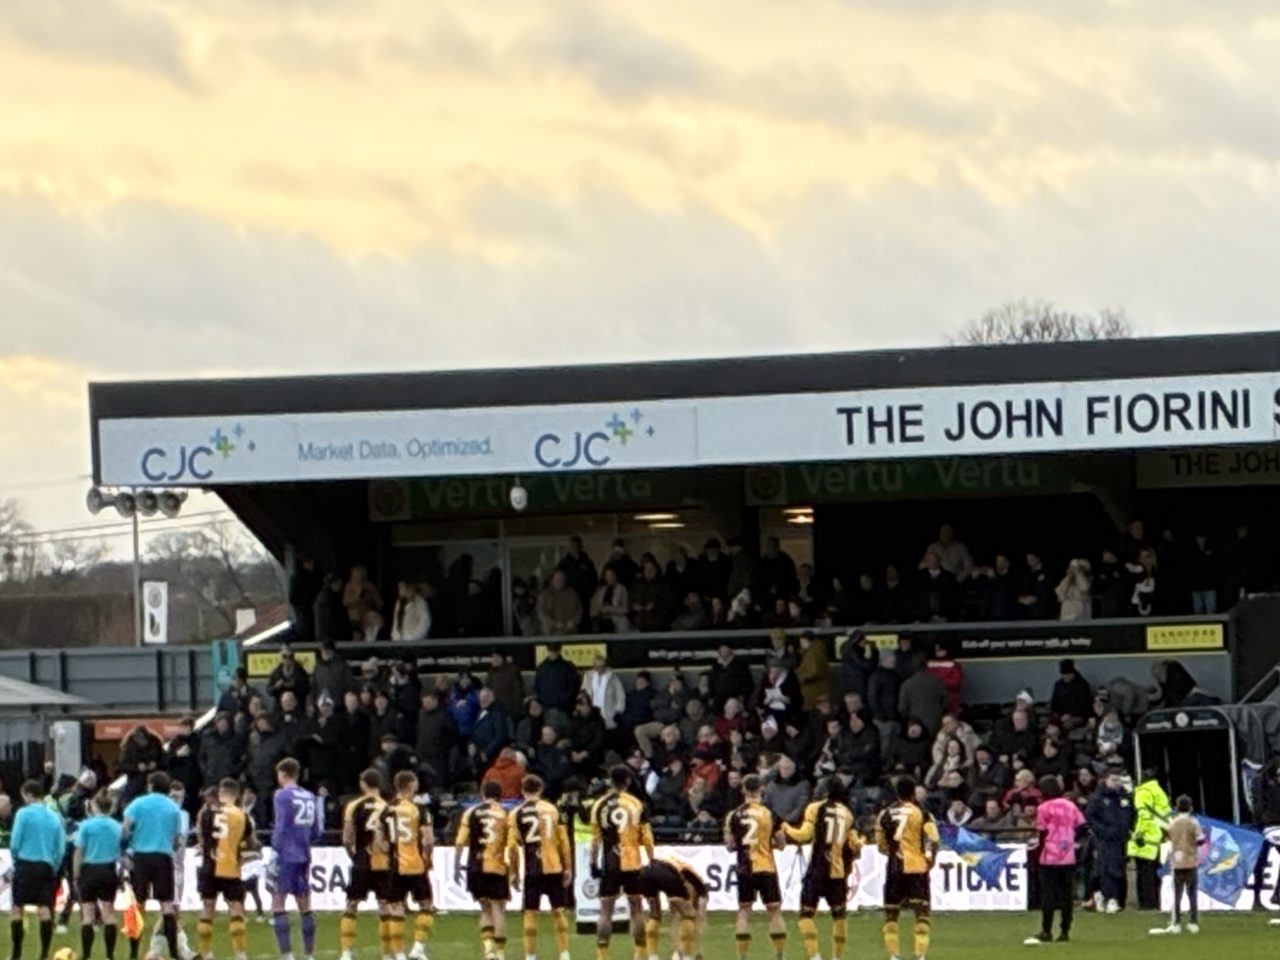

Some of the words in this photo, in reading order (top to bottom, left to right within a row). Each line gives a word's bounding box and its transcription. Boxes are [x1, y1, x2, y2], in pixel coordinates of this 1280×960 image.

[836, 404, 925, 446] THE
[944, 397, 1063, 442] JOHN
[1087, 387, 1252, 436] FIORINI
[298, 441, 354, 462] Market
[357, 438, 402, 459] Data.
[406, 435, 495, 459] Optimized.
[535, 431, 611, 468] CJC
[141, 445, 214, 481] CJC
[1170, 452, 1221, 476] THE
[211, 813, 229, 839] 5
[385, 816, 413, 843] 15
[479, 817, 497, 845] 3
[522, 816, 554, 843] 21
[740, 818, 759, 846] 2
[824, 816, 846, 845] 11
[891, 815, 908, 841] 7
